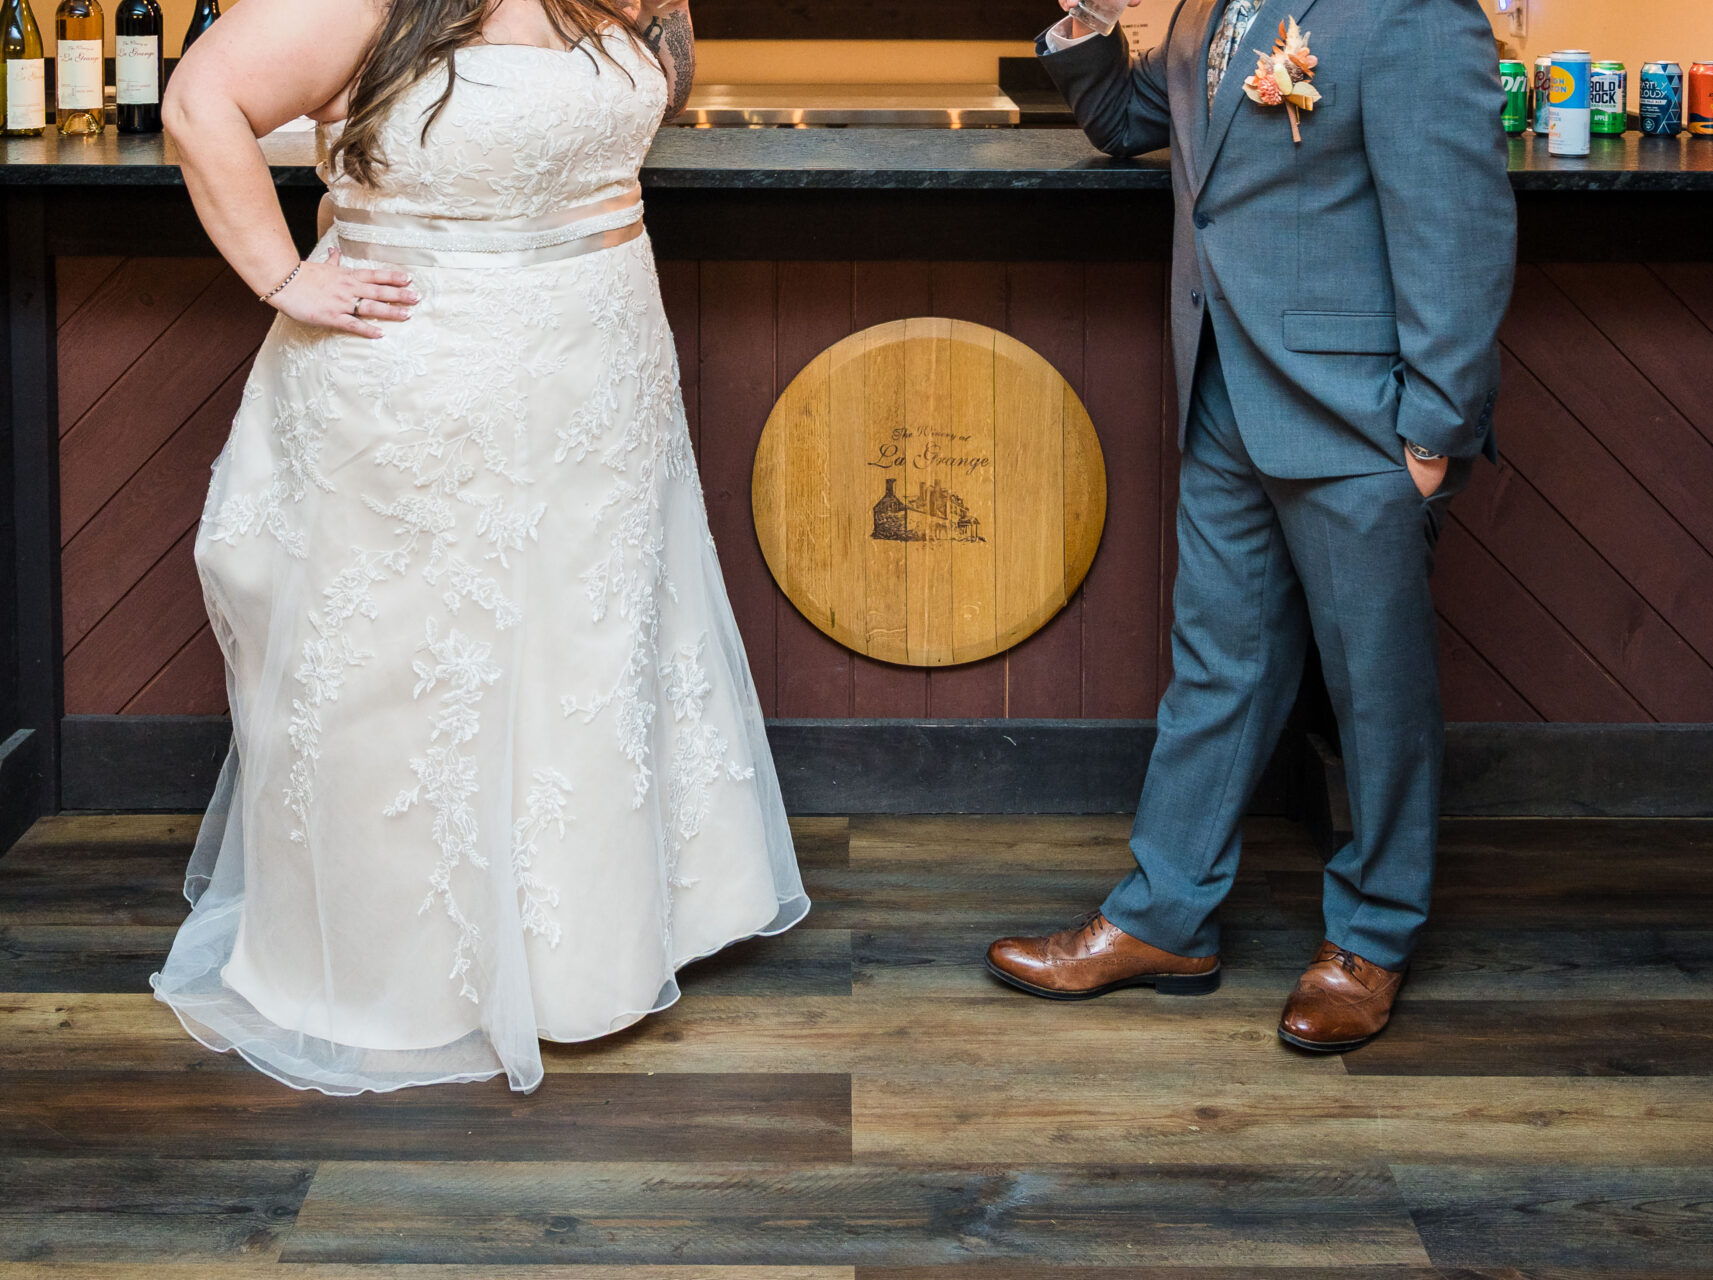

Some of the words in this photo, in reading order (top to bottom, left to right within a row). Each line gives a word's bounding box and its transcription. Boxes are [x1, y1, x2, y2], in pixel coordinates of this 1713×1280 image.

[1501, 76, 1527, 92] pri
[1590, 81, 1616, 93] BOLD
[1590, 92, 1617, 104] ROCK
[892, 427, 912, 441] The
[917, 425, 956, 440] Winery
[867, 443, 905, 469] La
[912, 441, 990, 476] Grange
